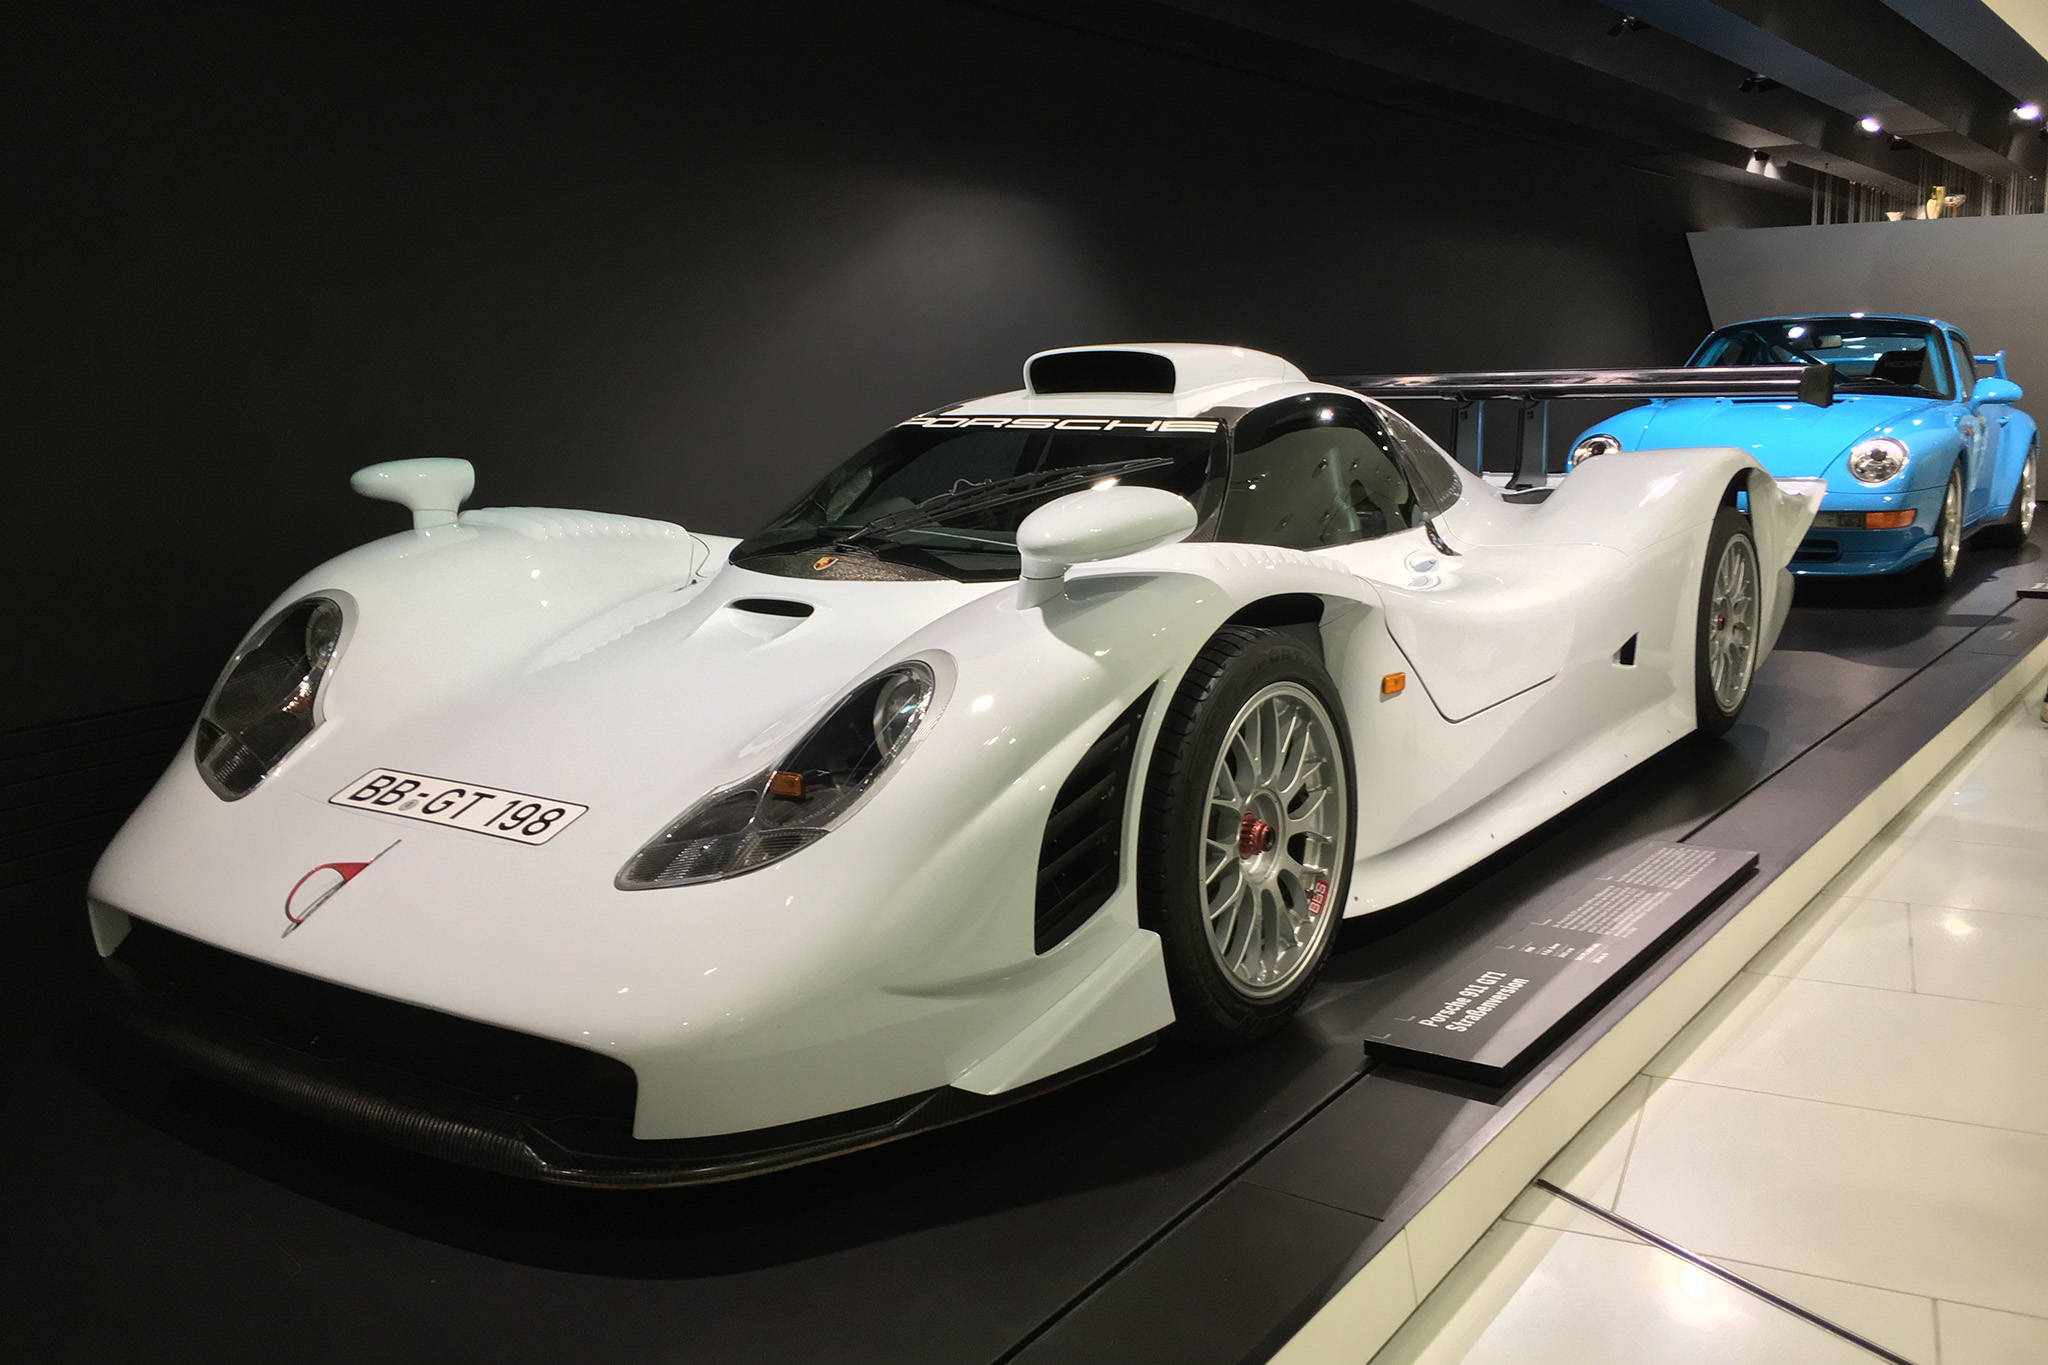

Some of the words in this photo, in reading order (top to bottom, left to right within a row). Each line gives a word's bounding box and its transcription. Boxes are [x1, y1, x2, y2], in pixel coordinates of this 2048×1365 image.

[895, 417, 1220, 433] PORSCHE
[347, 774, 496, 820] BB-GT
[484, 799, 567, 837] 198
[1308, 881, 1327, 914] BBS
[1418, 997, 1472, 1027] Porsche
[1458, 983, 1489, 998] 911
[1475, 970, 1507, 986] GT1
[1444, 977, 1530, 1032] Straßenversion
